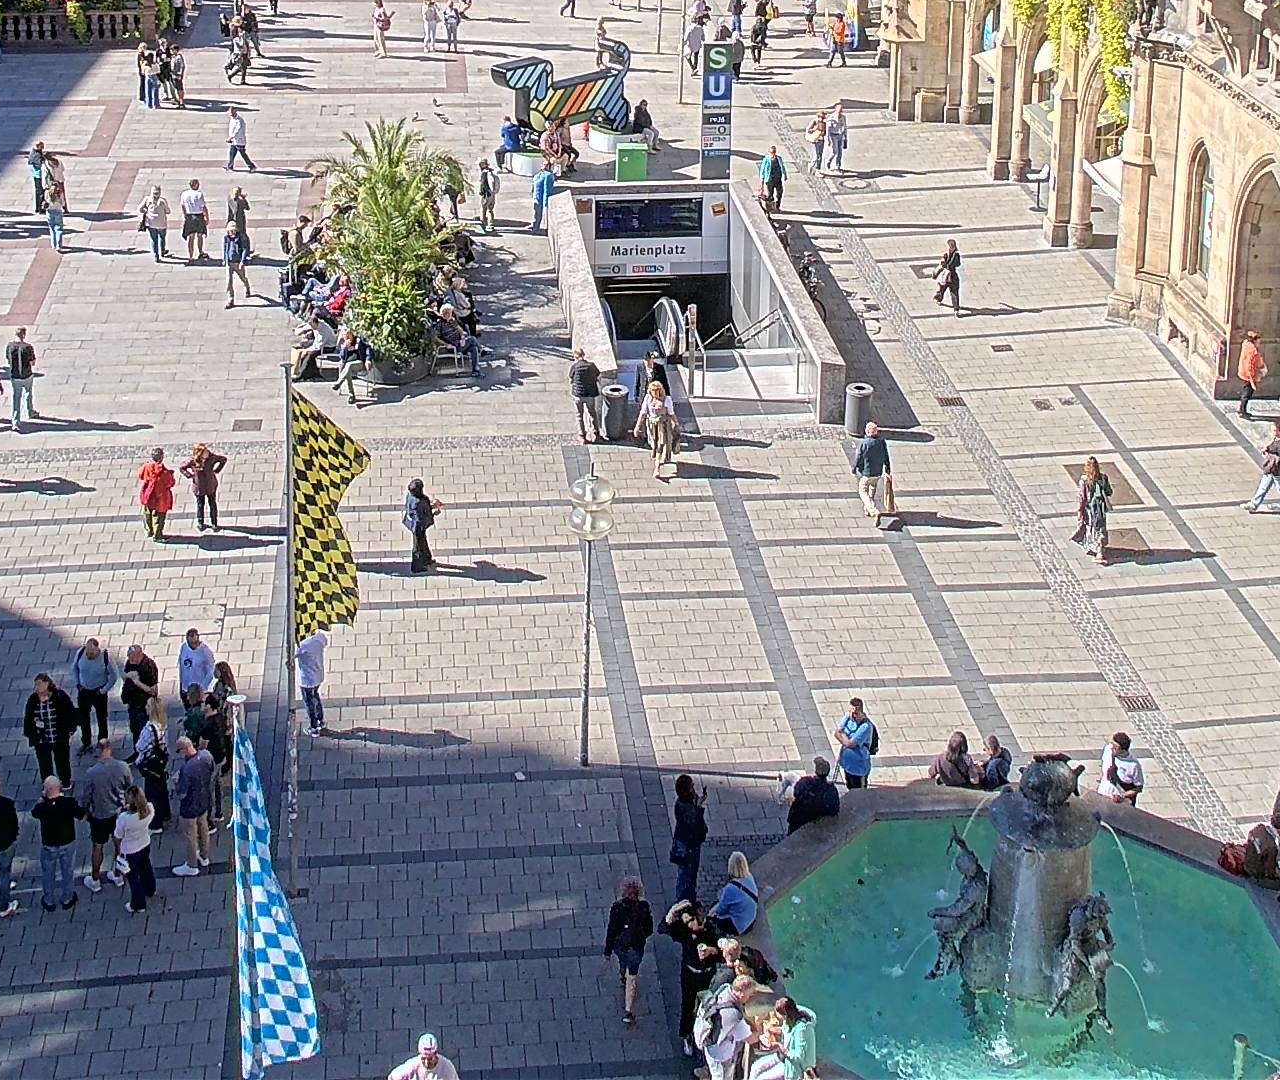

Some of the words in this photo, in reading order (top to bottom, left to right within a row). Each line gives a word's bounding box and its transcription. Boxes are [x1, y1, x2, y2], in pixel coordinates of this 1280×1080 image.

[709, 47, 727, 69] S
[708, 75, 726, 97] U
[610, 244, 687, 258] Marienplatz
